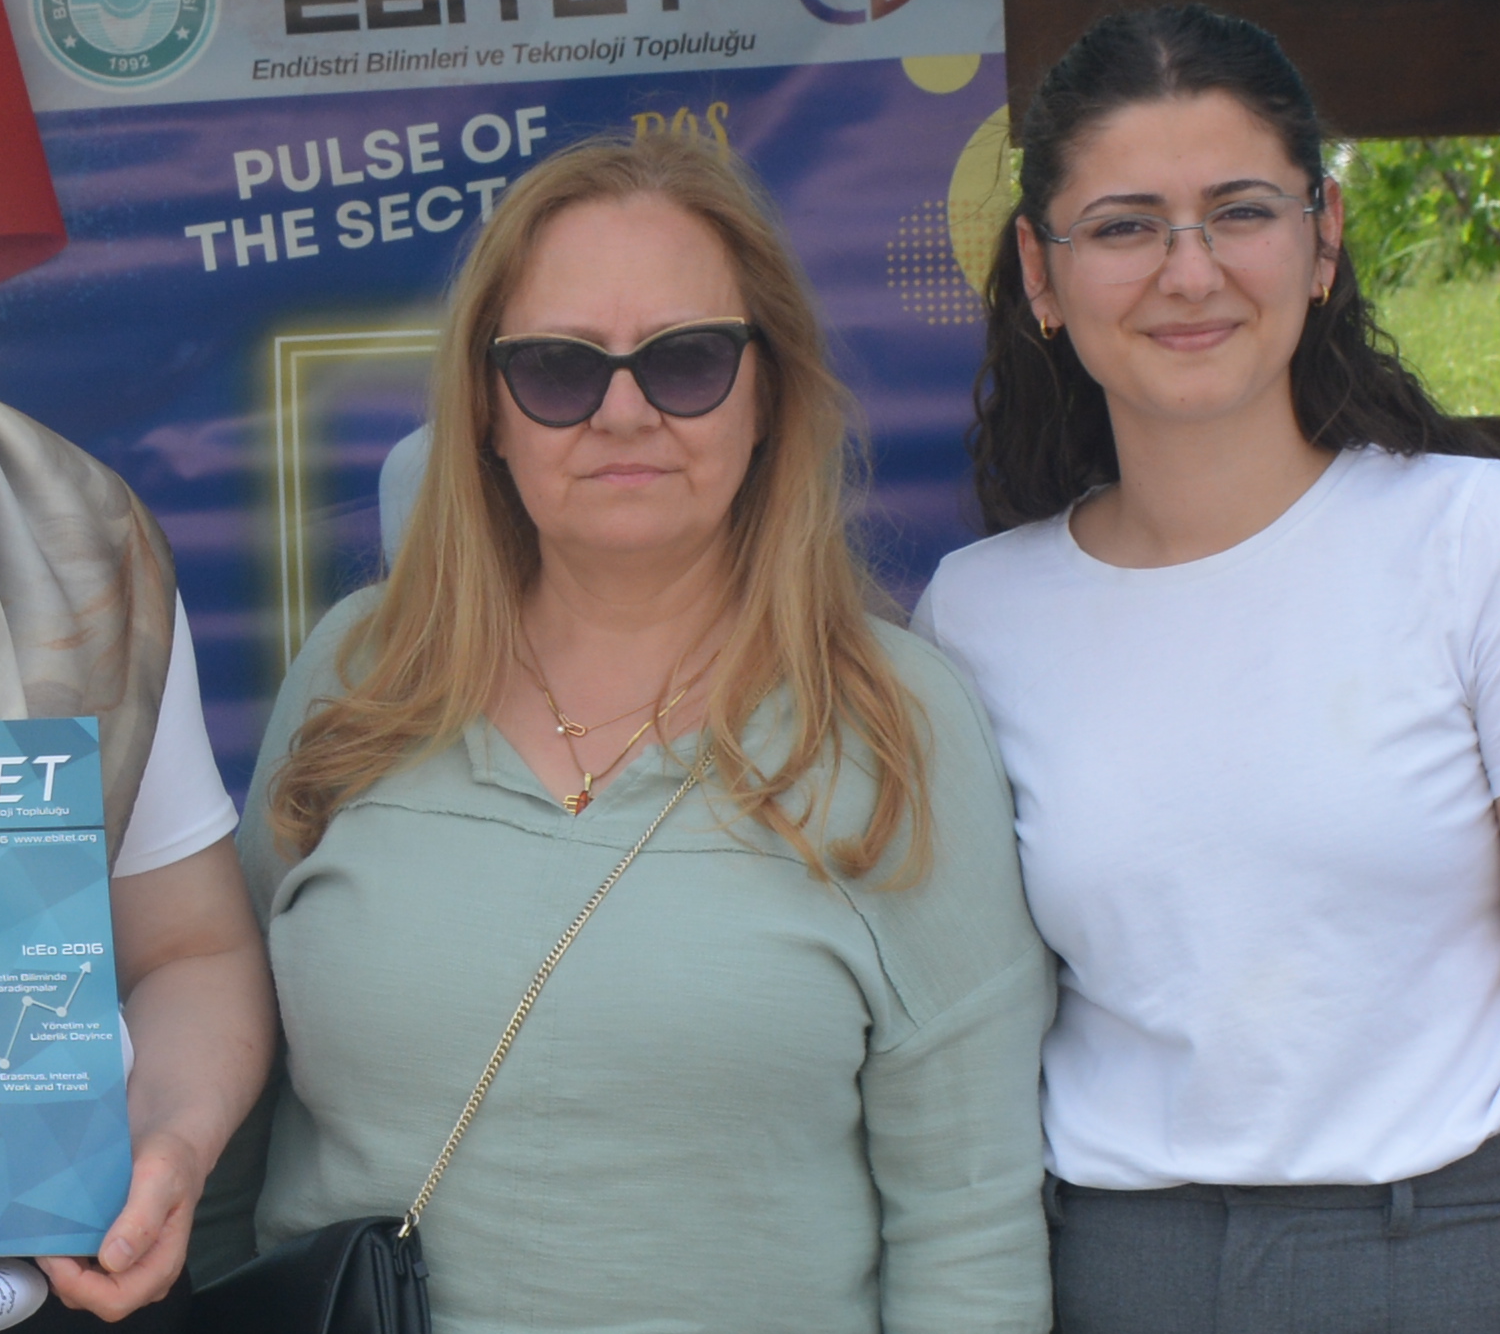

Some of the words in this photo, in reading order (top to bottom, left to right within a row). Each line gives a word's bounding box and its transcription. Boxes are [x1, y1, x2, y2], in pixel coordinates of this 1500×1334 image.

[251, 53, 360, 81] Endüstri
[366, 44, 469, 75] Bilimleri
[476, 49, 505, 68] ve
[512, 37, 626, 67] Teknoloji
[634, 28, 757, 62] Topluluğu
[108, 53, 151, 72] 1992
[233, 123, 444, 200] PULSE
[461, 105, 548, 163] OF
[184, 208, 320, 272] THE
[337, 177, 507, 250] SECT
[16, 805, 70, 818] Topluluğu
[13, 832, 97, 846] www.ebitet.org
[62, 942, 104, 955] 2016
[41, 1021, 84, 1031] Yönetim
[86, 1022, 100, 1030] ve
[69, 1031, 113, 1043] Deyince
[3, 1083, 32, 1092] Work
[34, 1082, 54, 1092] and
[56, 1082, 89, 1092] Travel
